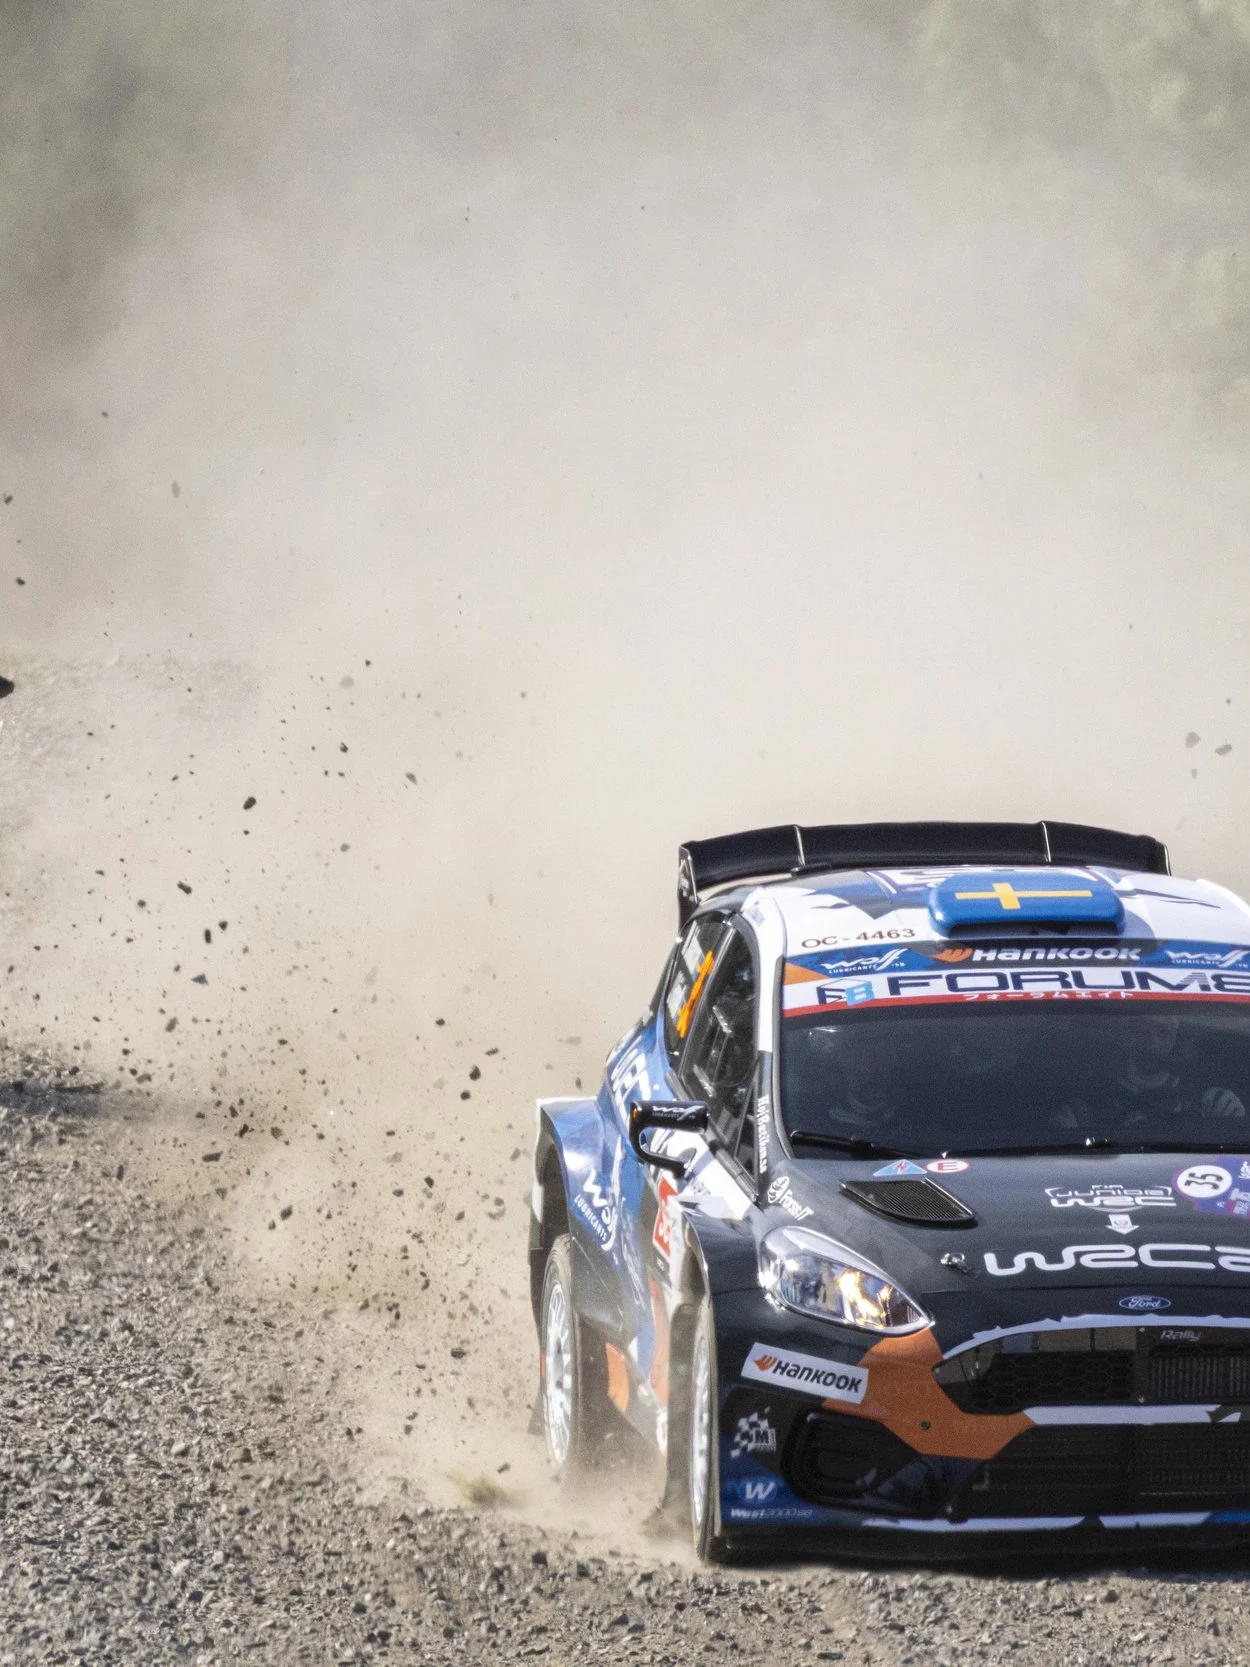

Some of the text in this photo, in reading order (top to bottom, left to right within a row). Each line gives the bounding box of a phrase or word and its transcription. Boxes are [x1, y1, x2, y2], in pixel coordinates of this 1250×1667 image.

[574, 1194, 608, 1242] LUBRICANTS
[1127, 1296, 1161, 1308] Ford
[1160, 1330, 1200, 1341] Rally
[744, 1481, 776, 1500] W
